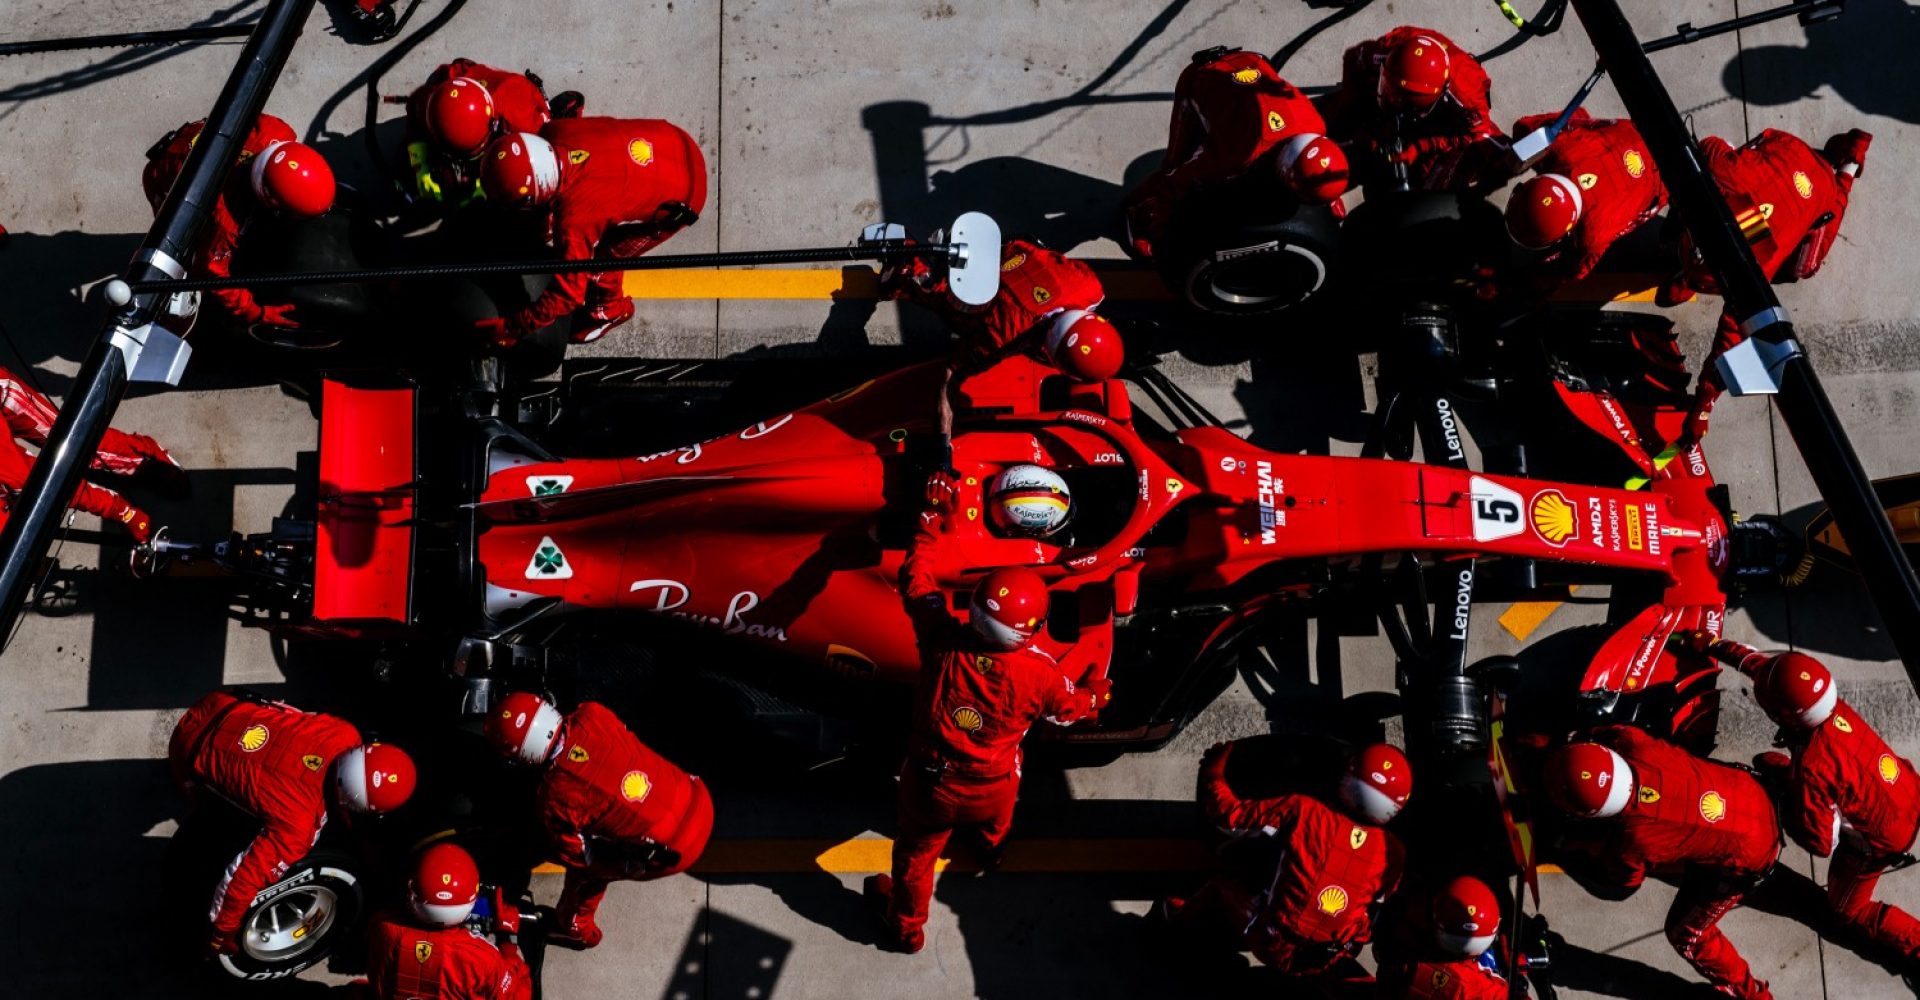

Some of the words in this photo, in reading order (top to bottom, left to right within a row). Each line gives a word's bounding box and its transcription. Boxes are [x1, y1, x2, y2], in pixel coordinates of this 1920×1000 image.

[1436, 398, 1464, 460] Lenovo
[1256, 460, 1276, 545] WEICHAI
[1478, 500, 1519, 524] 5
[1628, 508, 1640, 547] PIRELLI
[1645, 503, 1661, 555] MAHLE
[630, 579, 788, 642] Ray-Ban
[1450, 570, 1473, 640] Lenovo
